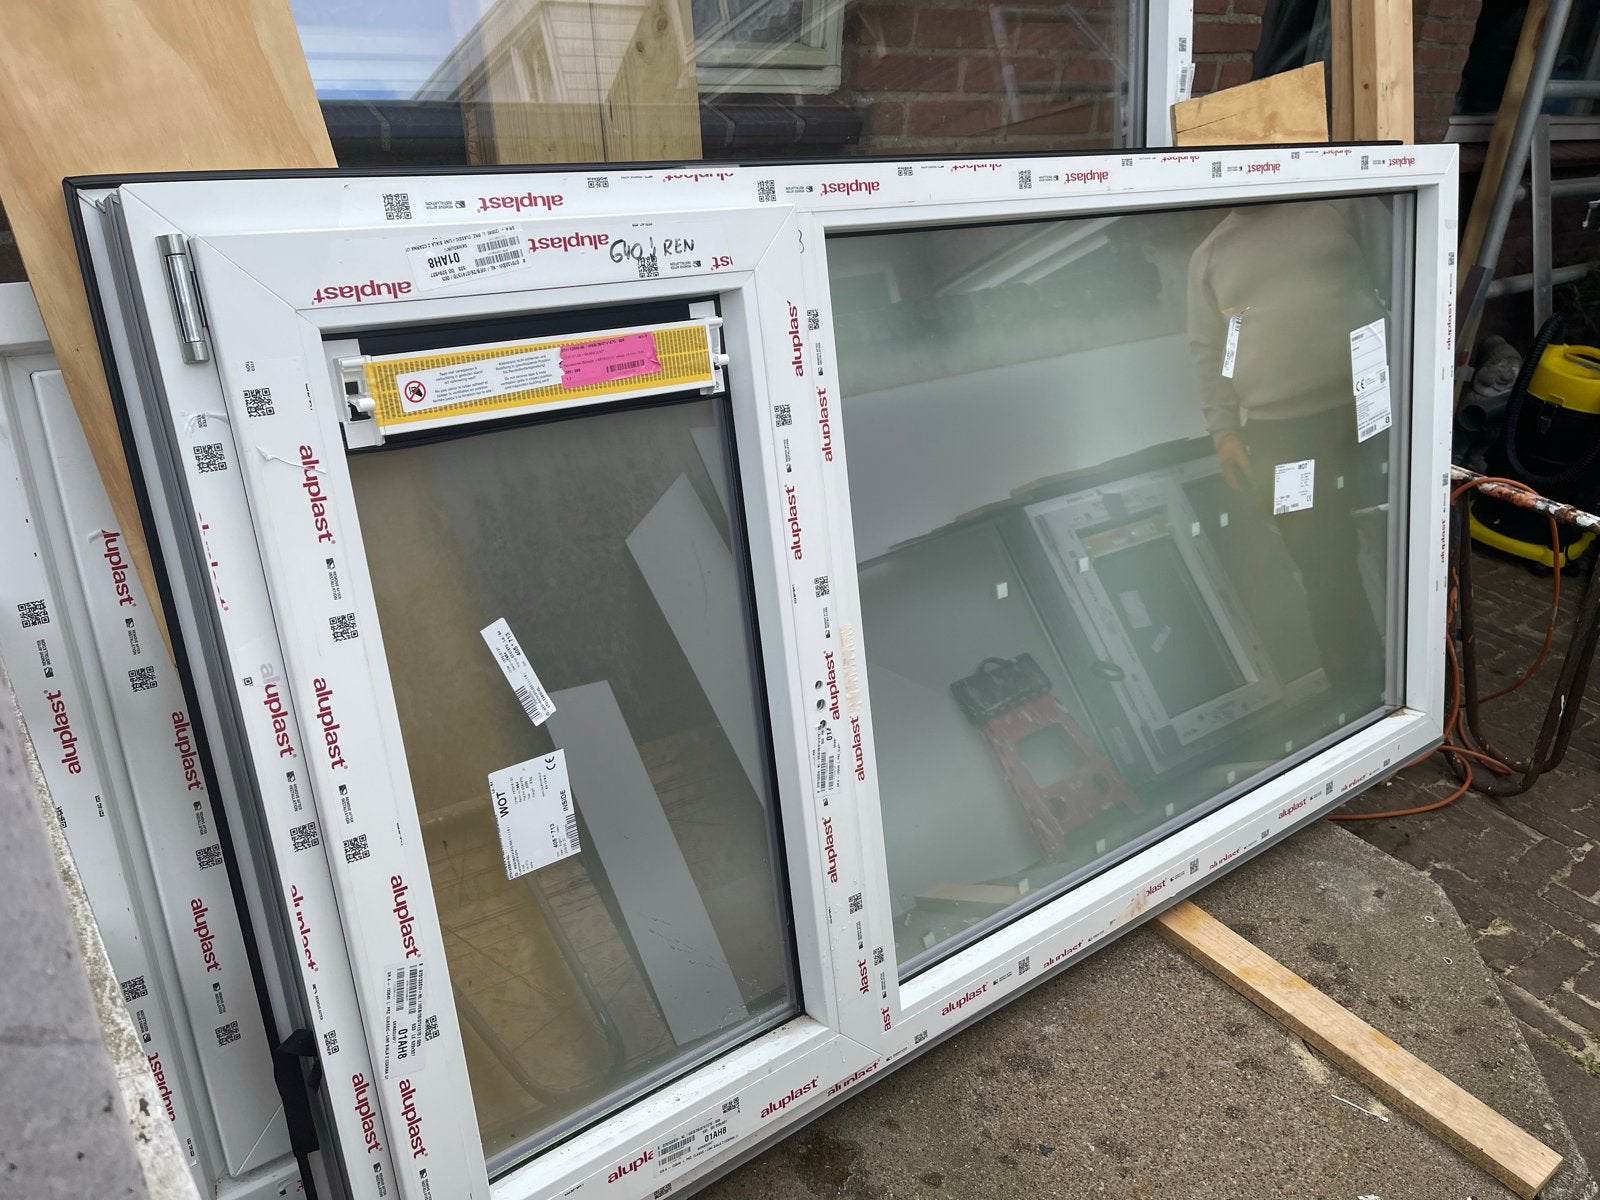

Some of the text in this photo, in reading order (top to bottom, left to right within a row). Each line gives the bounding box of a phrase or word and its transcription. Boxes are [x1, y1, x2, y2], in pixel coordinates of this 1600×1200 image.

[1065, 170, 1110, 183] aluplast
[1247, 162, 1281, 174] aluplast
[1388, 157, 1416, 167] aluplast
[478, 192, 564, 213] aluplast
[821, 180, 880, 195] aluplast
[528, 232, 609, 253] aluplast
[663, 238, 695, 257] REN
[428, 253, 460, 268] 01AH8
[313, 280, 412, 303] aluplast
[787, 300, 804, 377] aluplas
[818, 387, 833, 462] aluplast
[299, 445, 333, 543] aluplast
[785, 486, 802, 560] aluplast
[102, 530, 133, 606] luplast
[327, 571, 338, 601] INSTALLATION
[40, 638, 51, 665] INSTALLATION
[127, 629, 137, 655] INSTALLATION
[825, 652, 840, 721] aluplast
[47, 690, 81, 775] aluplast
[313, 677, 345, 769] aluplast
[172, 711, 201, 791] aluplast
[851, 716, 866, 782] aluplast
[288, 783, 299, 812] INSTALLATION
[494, 790, 510, 817] WOT
[558, 789, 569, 811] INSIDE
[1278, 798, 1307, 819] aluplast
[822, 817, 838, 883] aluplast
[390, 875, 419, 959] aluplast
[190, 898, 220, 973] aluplast
[941, 984, 987, 1016] aluplast
[397, 1028, 408, 1060] 01AH8
[351, 1072, 380, 1154] aluplast
[760, 1077, 818, 1119] aluplast
[399, 1078, 426, 1160] aluplast
[704, 1126, 727, 1143] 01AH8
